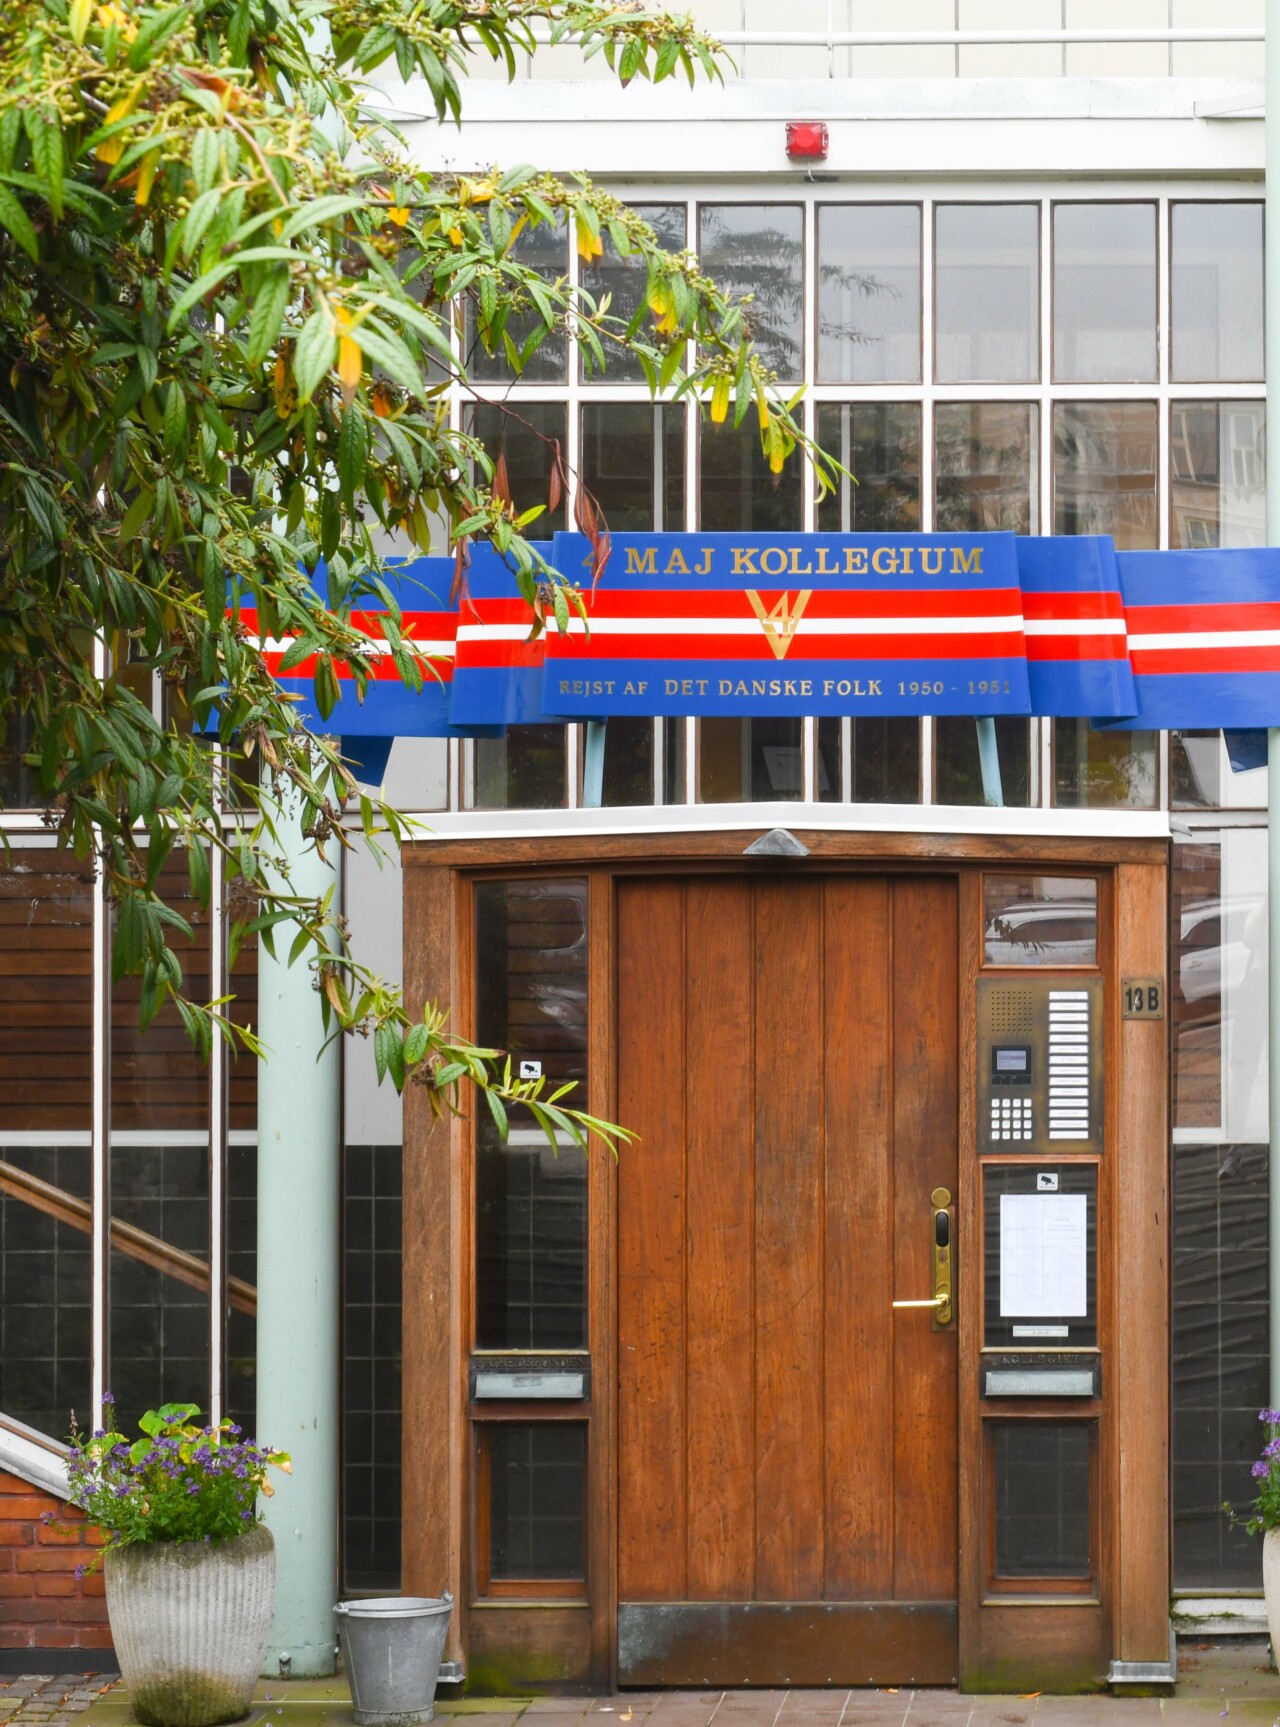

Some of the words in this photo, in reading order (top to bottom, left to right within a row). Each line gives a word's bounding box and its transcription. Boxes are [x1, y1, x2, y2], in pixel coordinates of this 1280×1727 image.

[624, 547, 715, 575] MAJ
[730, 547, 984, 575] KOLLEGIUM
[559, 680, 615, 697] REJST
[623, 681, 648, 695] AF
[664, 679, 709, 696] DET
[719, 679, 813, 697] DANSKE
[822, 679, 882, 697] FOLK
[898, 681, 945, 696] 1950
[968, 680, 1011, 695] 1951
